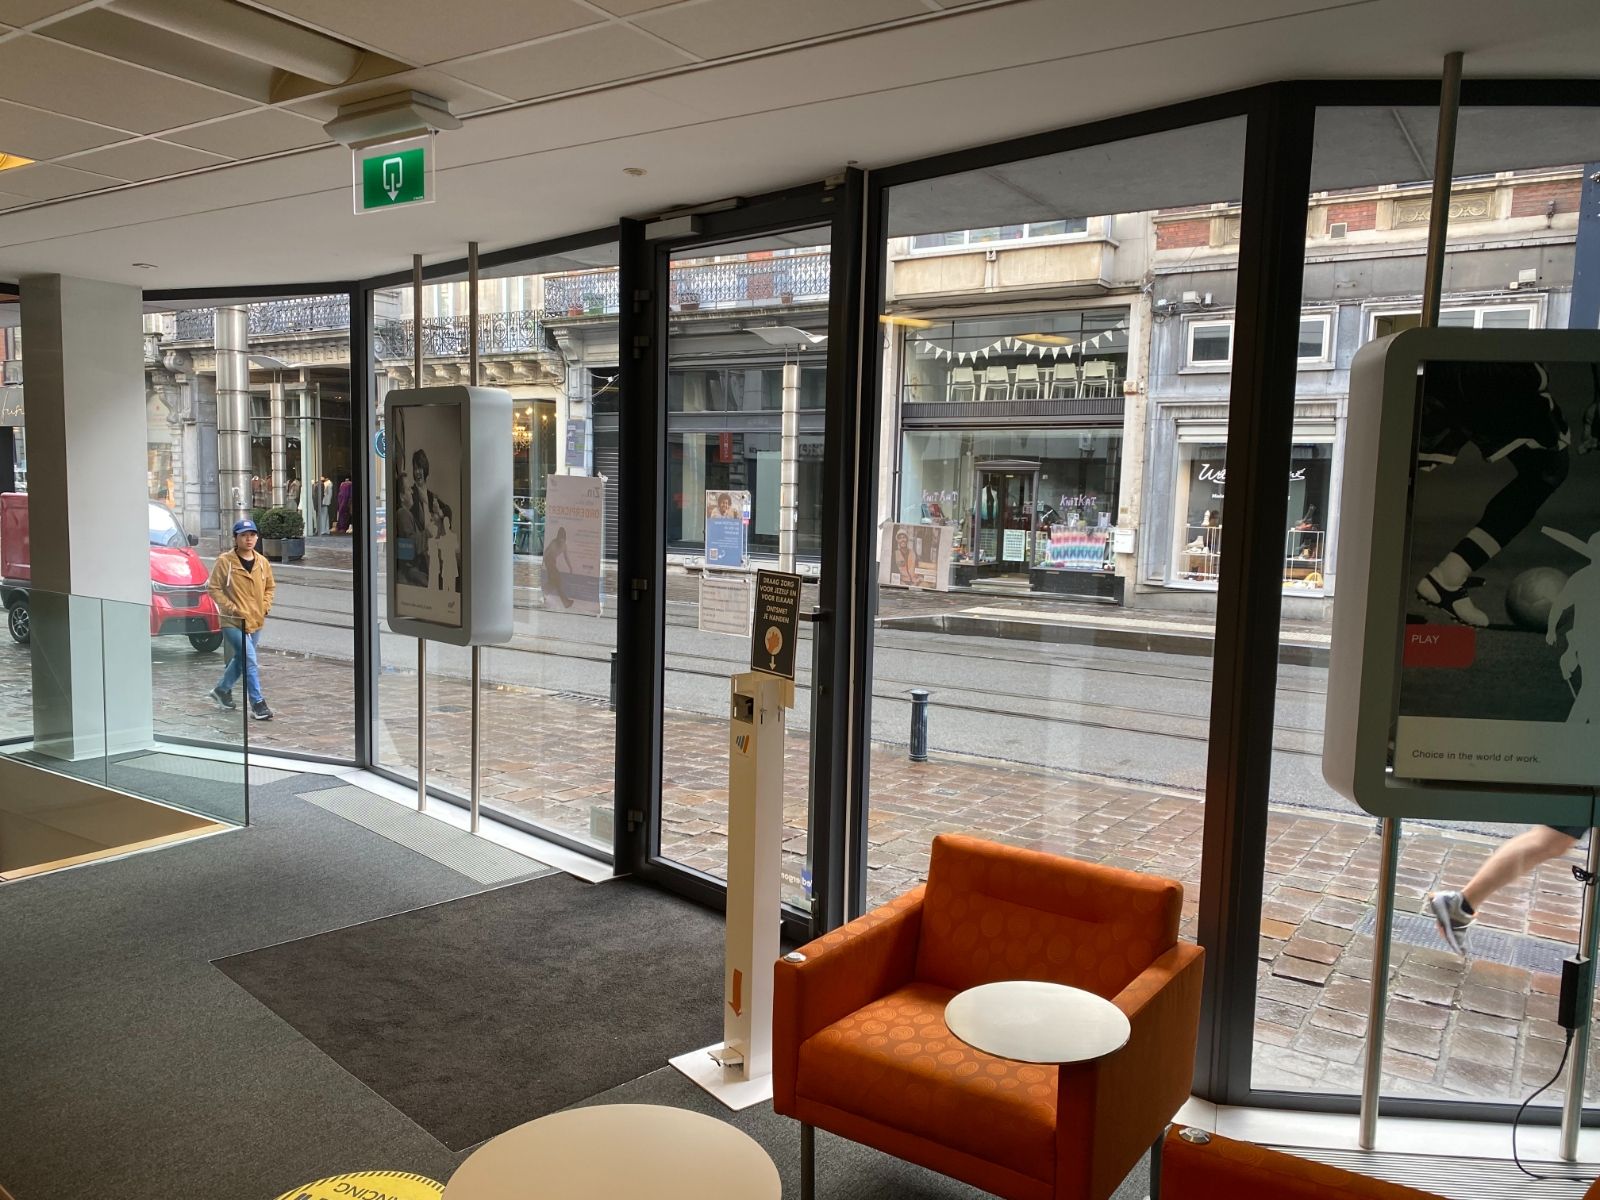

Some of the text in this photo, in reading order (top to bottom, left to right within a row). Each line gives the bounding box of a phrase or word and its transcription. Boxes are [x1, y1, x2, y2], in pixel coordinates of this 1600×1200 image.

[763, 577, 795, 588] DRAAG ZORG
[760, 585, 797, 597] VOOR JEZELF EN
[762, 593, 794, 605] VOOR ELKAAR
[767, 605, 788, 615] ONTSMET
[769, 614, 790, 624] HANDEN
[1411, 634, 1440, 644] PLAY
[1412, 749, 1444, 759] Choice
[1447, 752, 1456, 760] in
[1459, 752, 1473, 761] the
[1476, 753, 1502, 762] world
[1504, 754, 1514, 762] of
[333, 1182, 399, 1200] NCING
